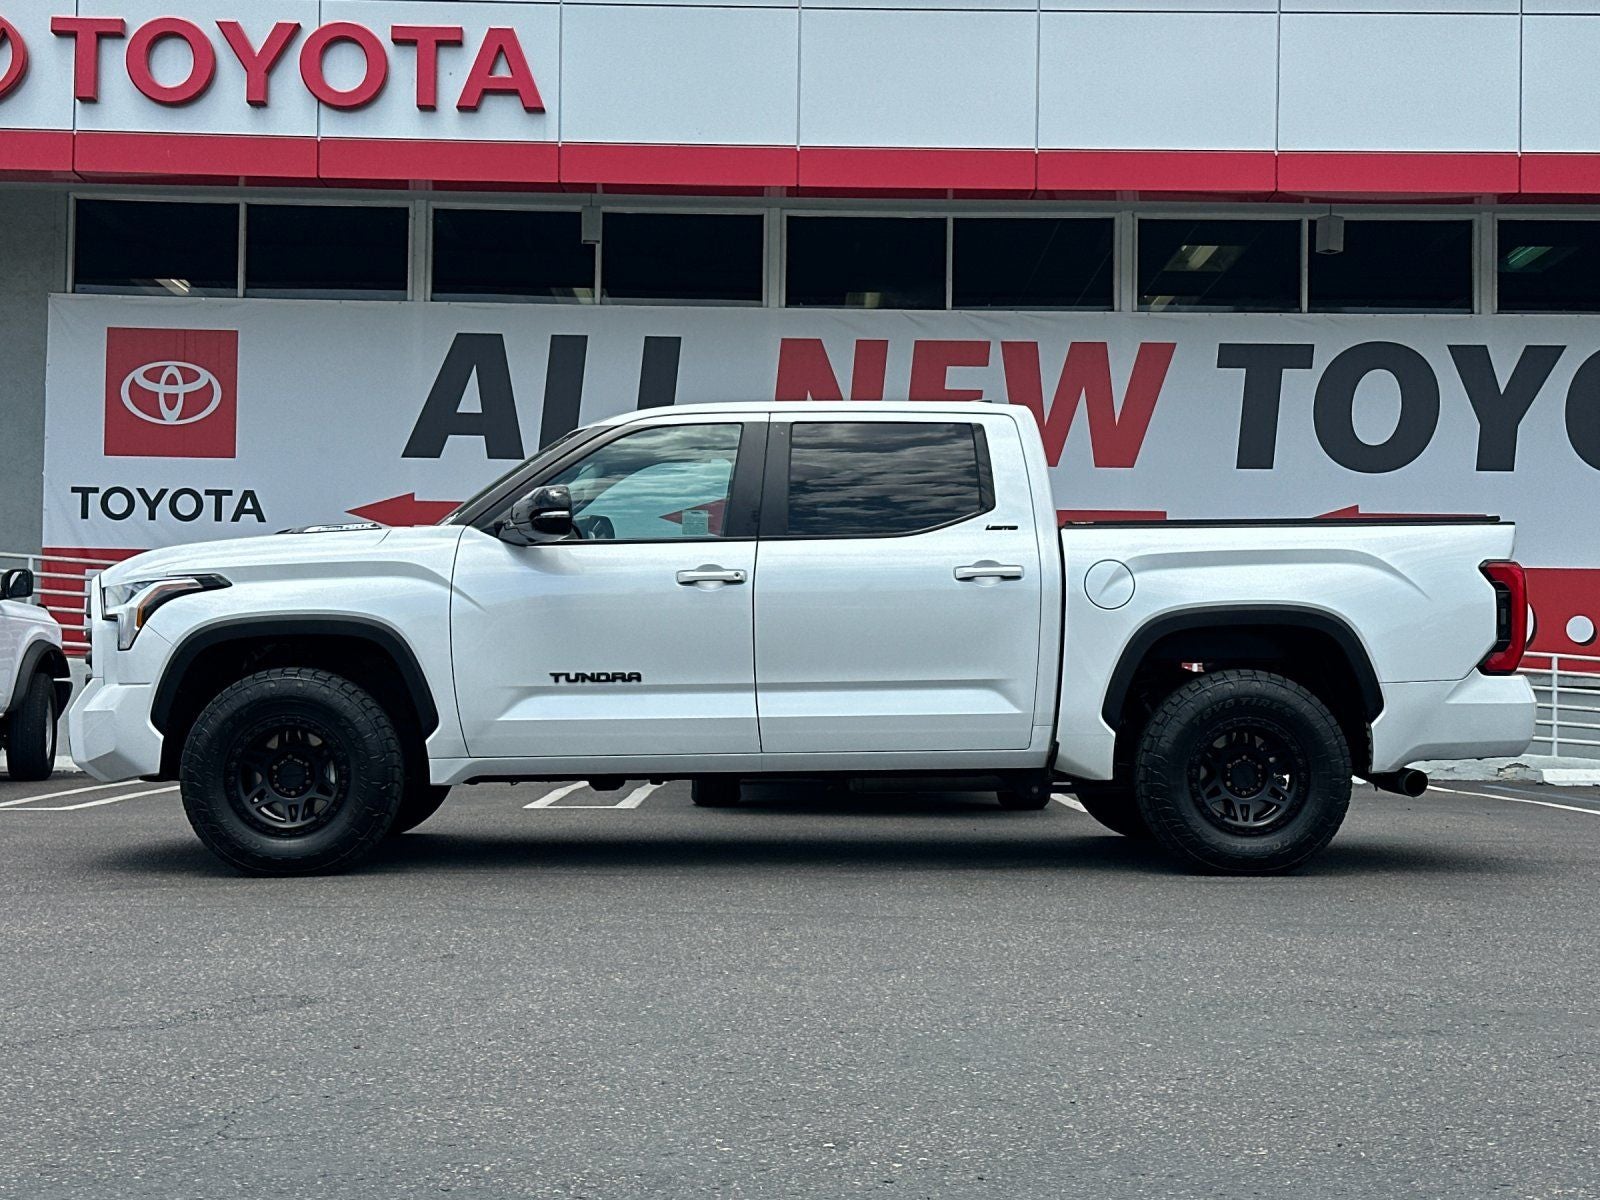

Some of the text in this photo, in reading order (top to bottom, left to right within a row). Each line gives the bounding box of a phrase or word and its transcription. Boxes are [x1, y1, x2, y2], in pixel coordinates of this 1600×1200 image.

[50, 16, 547, 114] TOYOTA
[1216, 341, 1600, 474] TOY
[71, 486, 267, 522] TOYOTA
[549, 672, 642, 683] TUNDRA
